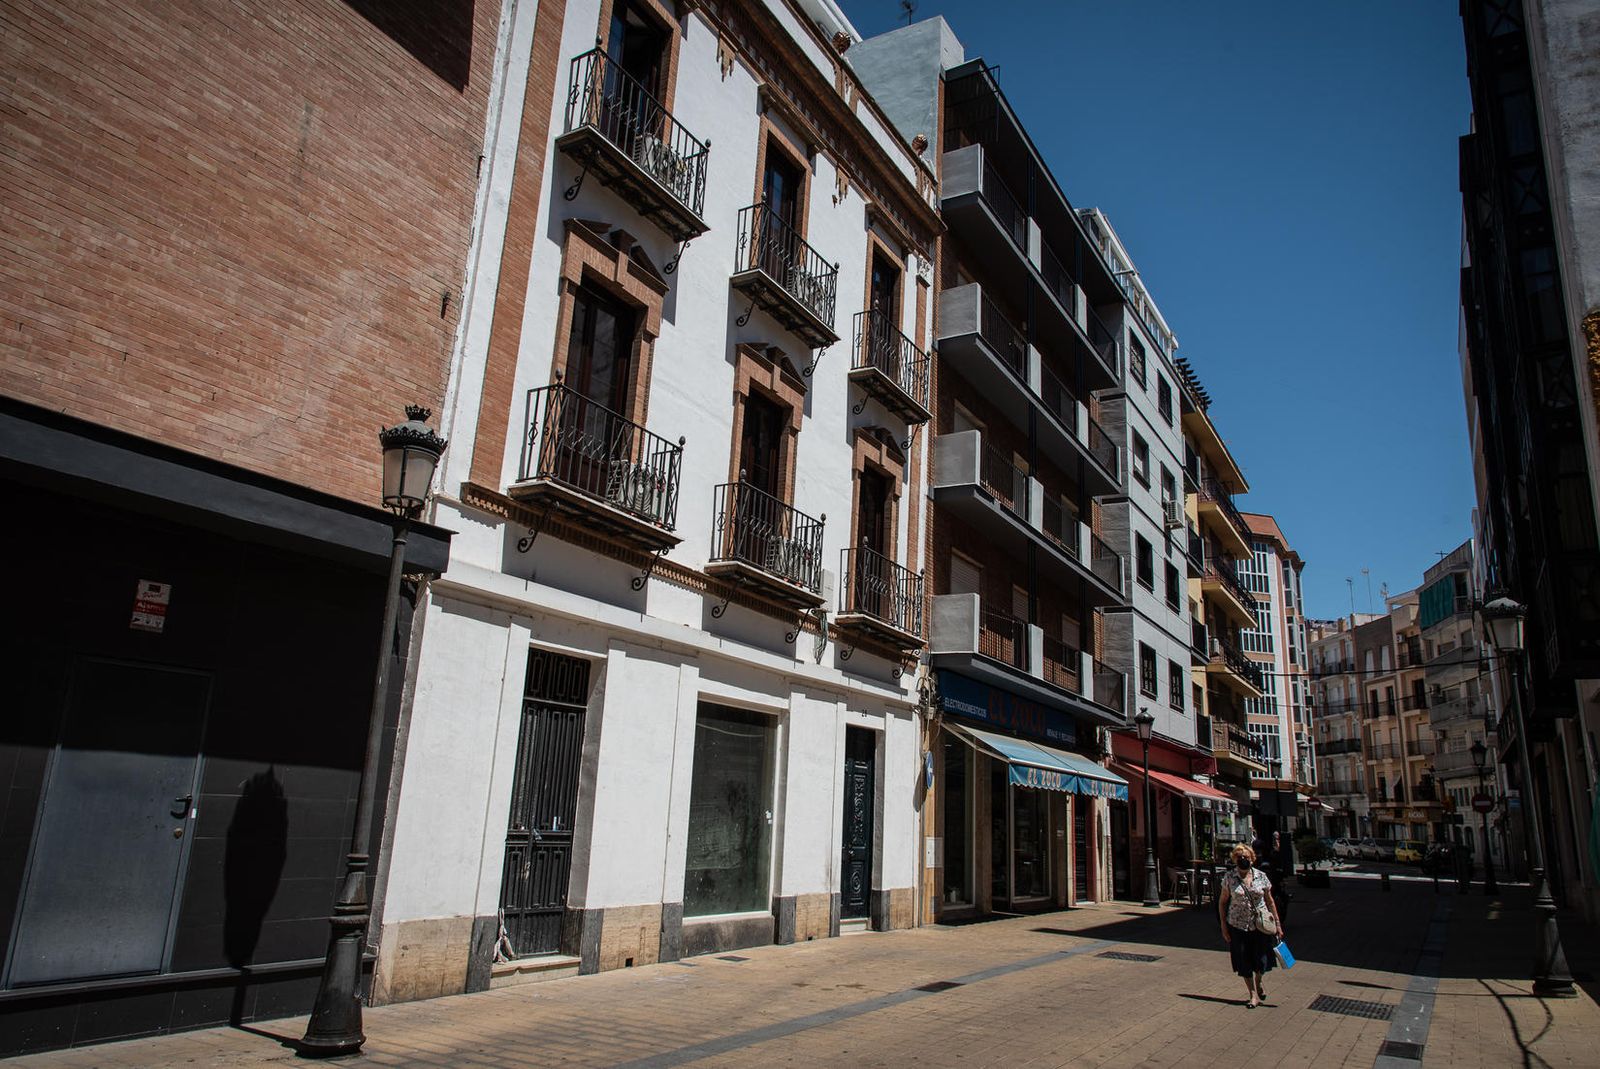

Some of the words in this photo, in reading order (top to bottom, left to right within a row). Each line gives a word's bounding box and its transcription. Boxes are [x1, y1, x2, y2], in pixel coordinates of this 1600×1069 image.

[944, 697, 987, 718] ELECTRODOMESTICOS
[988, 688, 1008, 723] EL
[1011, 696, 1046, 736] ZOCO
[1027, 767, 1038, 785] EL
[1041, 770, 1061, 788] ZOCO
